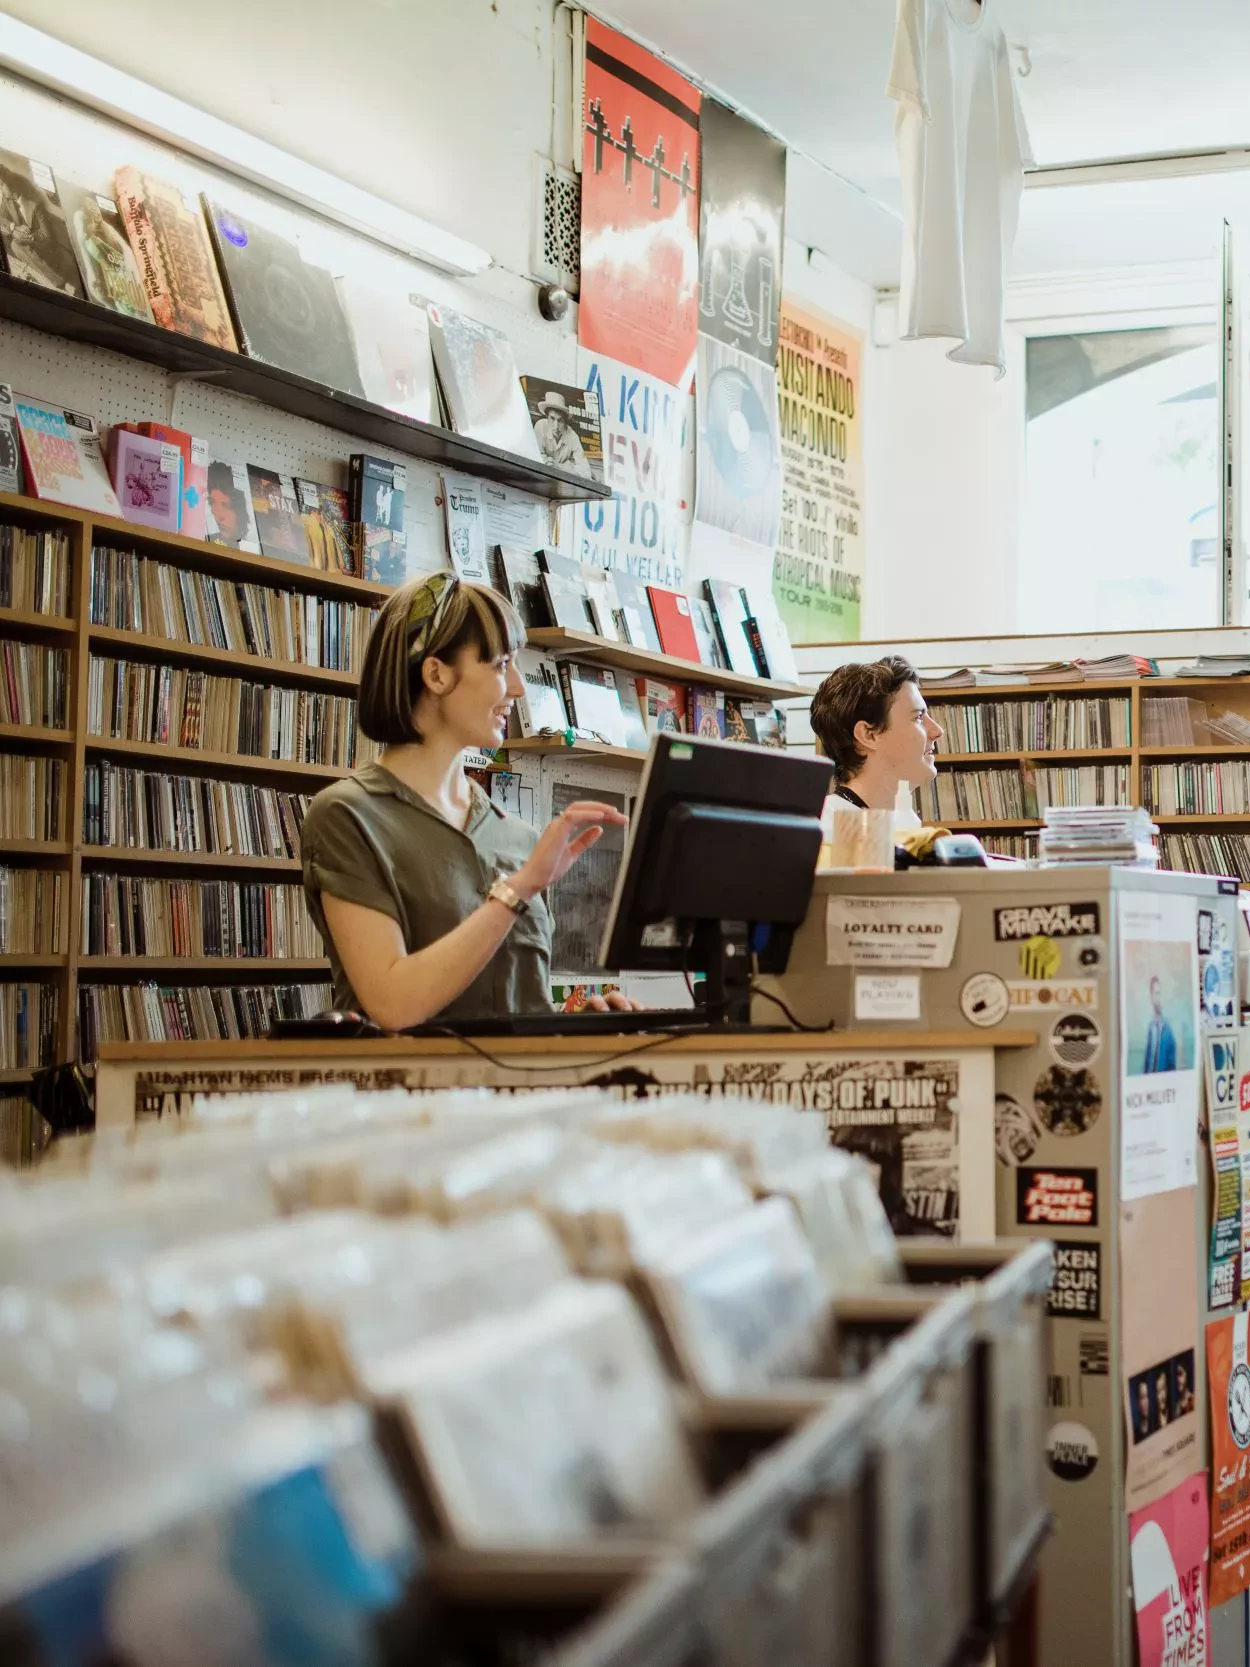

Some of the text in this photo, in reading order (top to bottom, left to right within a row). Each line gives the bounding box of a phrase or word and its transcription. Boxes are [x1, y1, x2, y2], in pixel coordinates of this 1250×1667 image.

[139, 239, 161, 298] Springfield
[463, 753, 487, 766] TATED
[844, 923, 943, 934] LOYALTY CARD
[1000, 914, 1095, 938] MISTAKE
[772, 1081, 833, 1108] DAYS
[839, 1080, 869, 1108] OF
[827, 1109, 894, 1127] TERTAINMENT
[1035, 1173, 1083, 1191] Ten
[1025, 1188, 1092, 1207] Foot
[1028, 1203, 1092, 1221] Pole
[1052, 1250, 1097, 1268] AKEN
[1054, 1441, 1088, 1453] INNER
[1170, 1564, 1201, 1607] LIVE
[1166, 1596, 1204, 1650] FROM
[1165, 1628, 1205, 1667] TIMES
